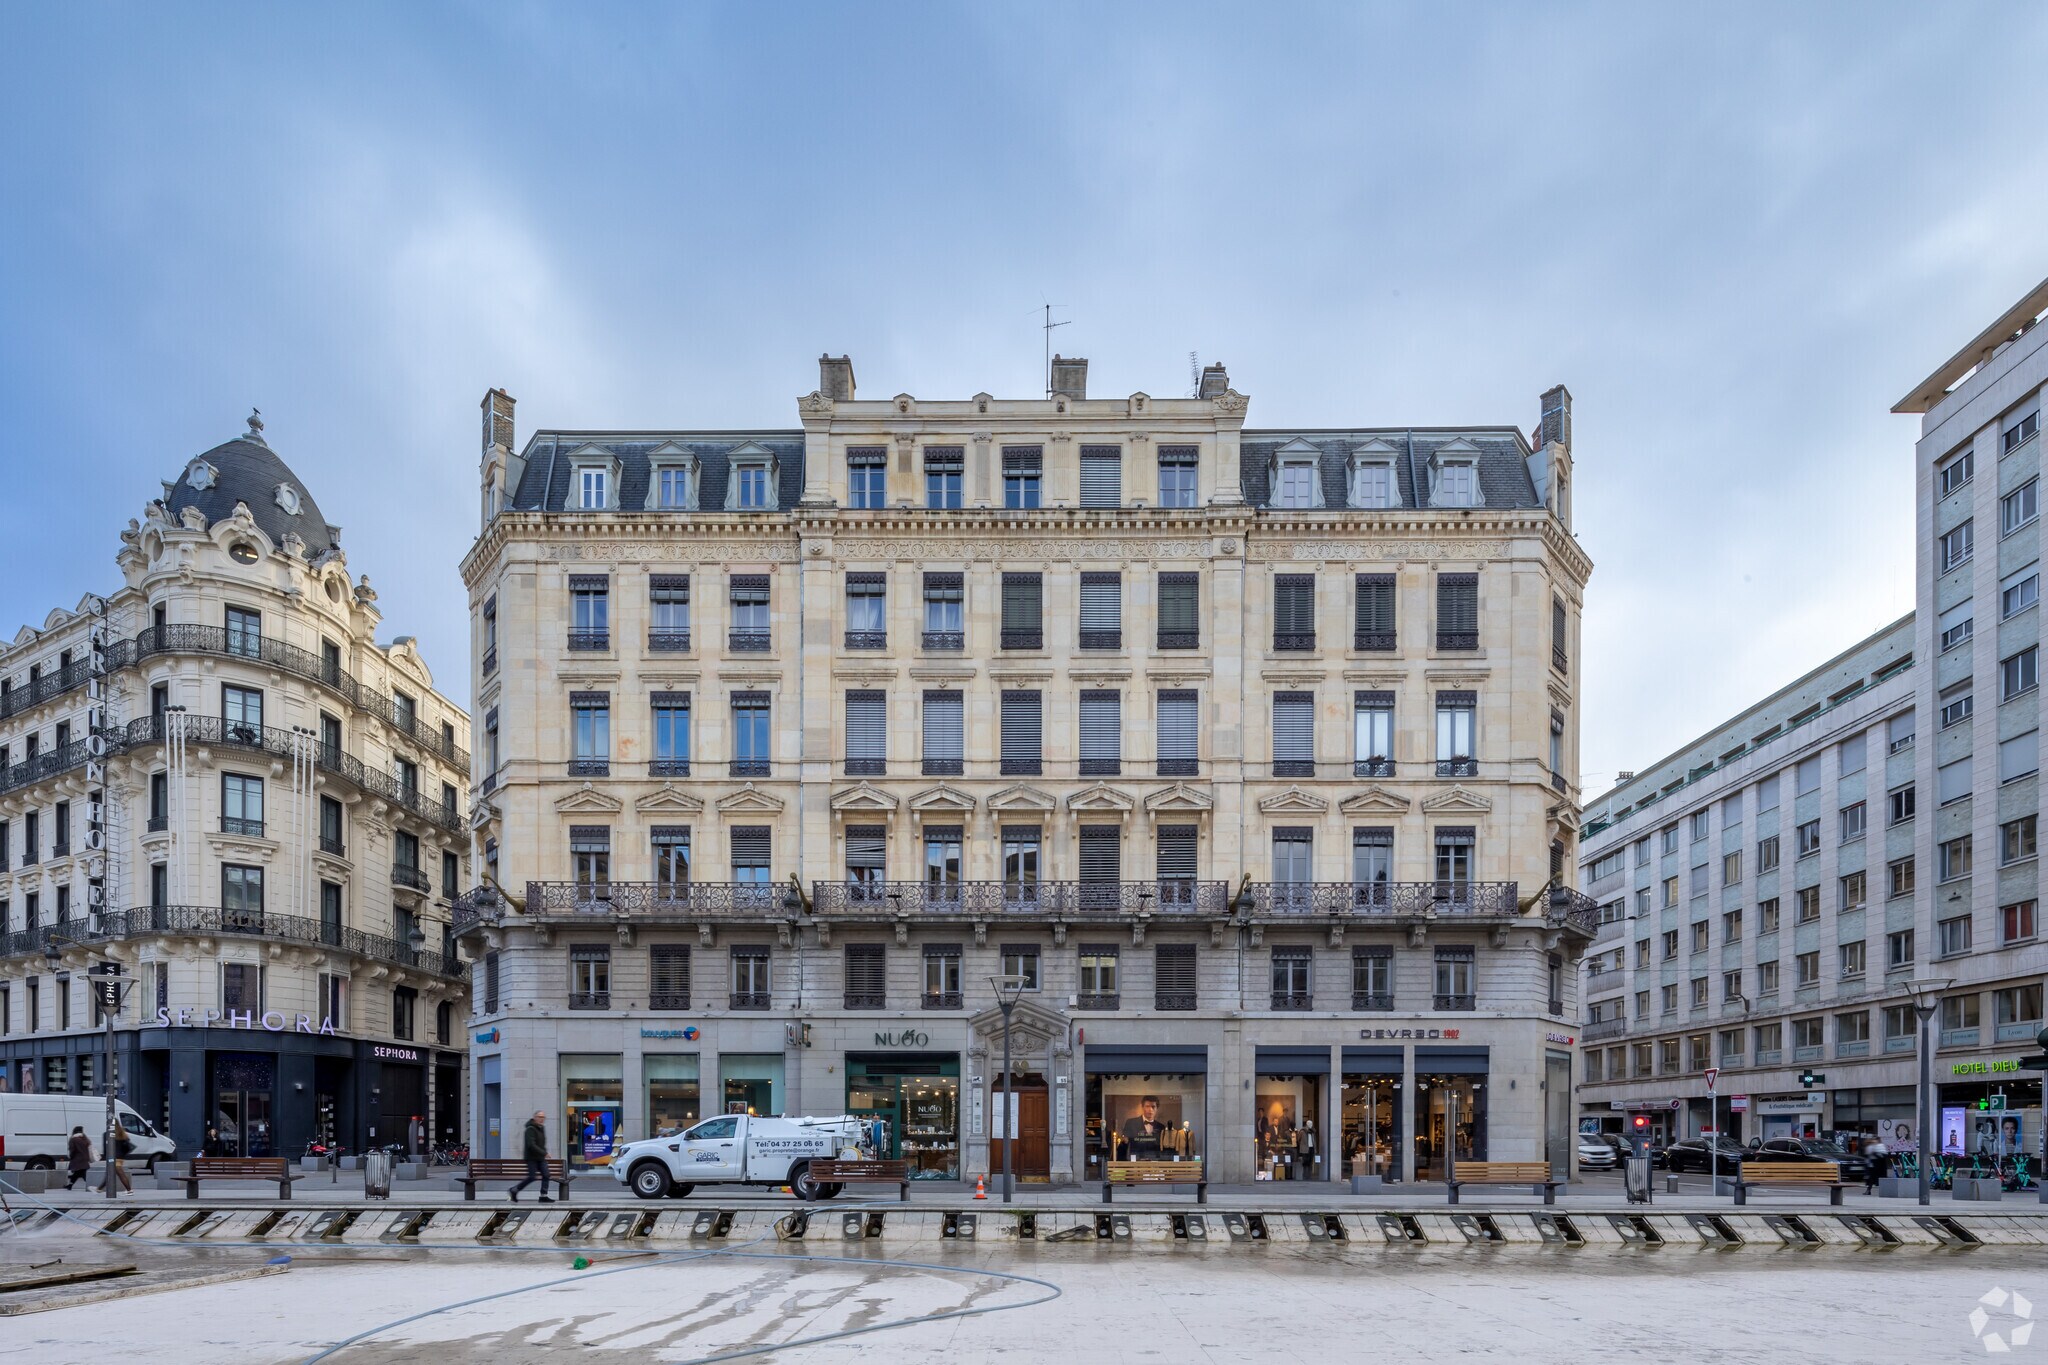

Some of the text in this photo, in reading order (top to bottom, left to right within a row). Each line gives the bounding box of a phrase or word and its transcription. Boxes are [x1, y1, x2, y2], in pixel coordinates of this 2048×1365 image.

[85, 800, 106, 936] HOTEL
[201, 912, 279, 931] CARLTON
[157, 1006, 335, 1036] SEPHORA
[1443, 1029, 1460, 1040] 1902
[374, 1046, 418, 1060] SEPHORA
[1952, 1060, 2019, 1075] HOTEL DIEU
[1992, 1098, 1999, 1108] P
[697, 1151, 719, 1159] GARIC
